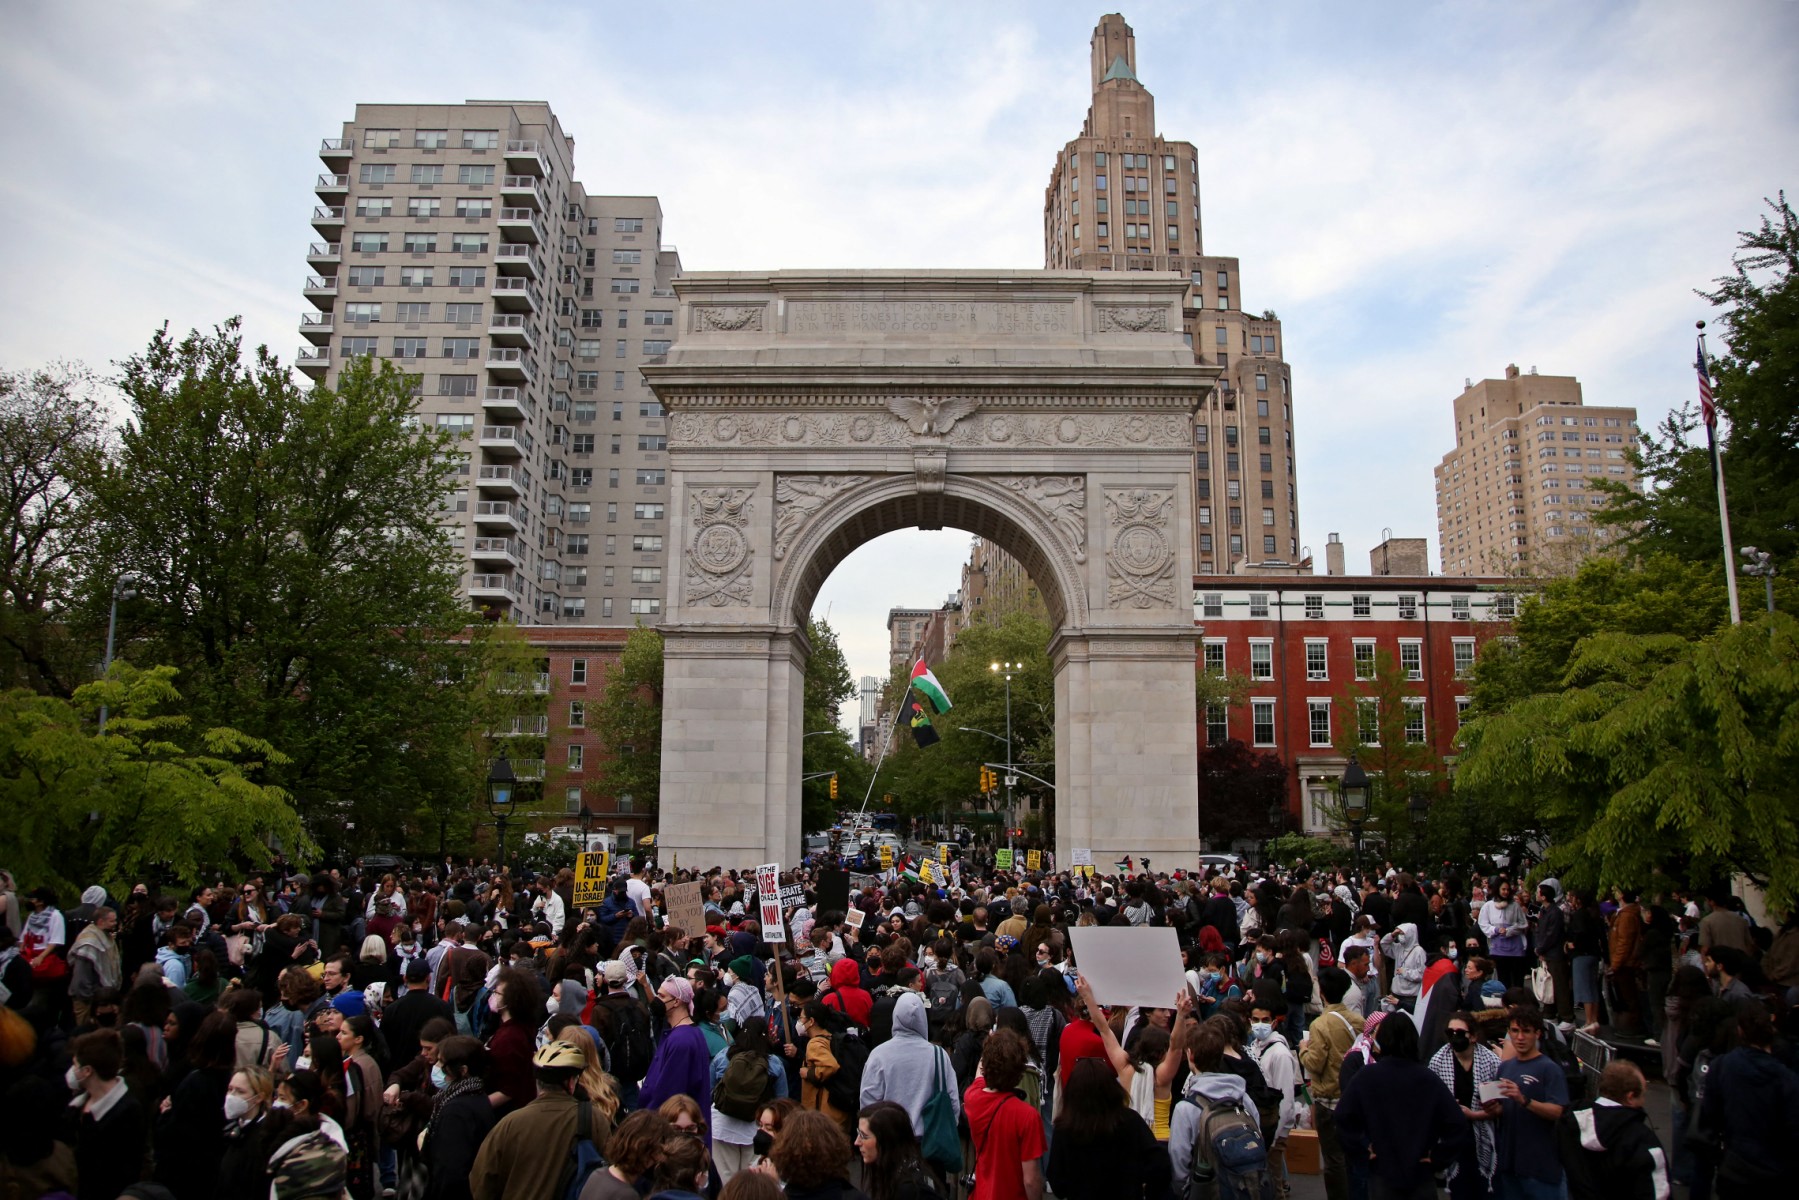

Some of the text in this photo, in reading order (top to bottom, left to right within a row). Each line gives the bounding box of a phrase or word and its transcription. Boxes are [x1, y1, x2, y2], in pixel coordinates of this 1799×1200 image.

[795, 303, 817, 312] LET
[820, 303, 832, 312] US
[835, 303, 868, 312] RAISE
[884, 303, 946, 312] STANDARD
[950, 303, 967, 312] TO
[970, 303, 1008, 312] WHICH
[1012, 303, 1035, 312] THE
[1038, 304, 1066, 312] WISE
[794, 313, 1067, 322] AND THE HONEST CAN REPAIR THE EVENT
[794, 322, 938, 331] IS IN THE HAND OF GOD
[988, 323, 1068, 332] WASHINGTON
[584, 853, 603, 866] END
[583, 866, 601, 879] ALL
[575, 881, 590, 893] U.S.
[759, 873, 776, 894] SIGE
[574, 893, 581, 902] TO
[779, 885, 803, 898] BERATE
[666, 892, 701, 908] BROUGHT
[780, 895, 806, 908] LESTINE
[668, 907, 702, 919] TO YOU
[763, 904, 780, 925] NW!
[678, 918, 690, 928] BY
